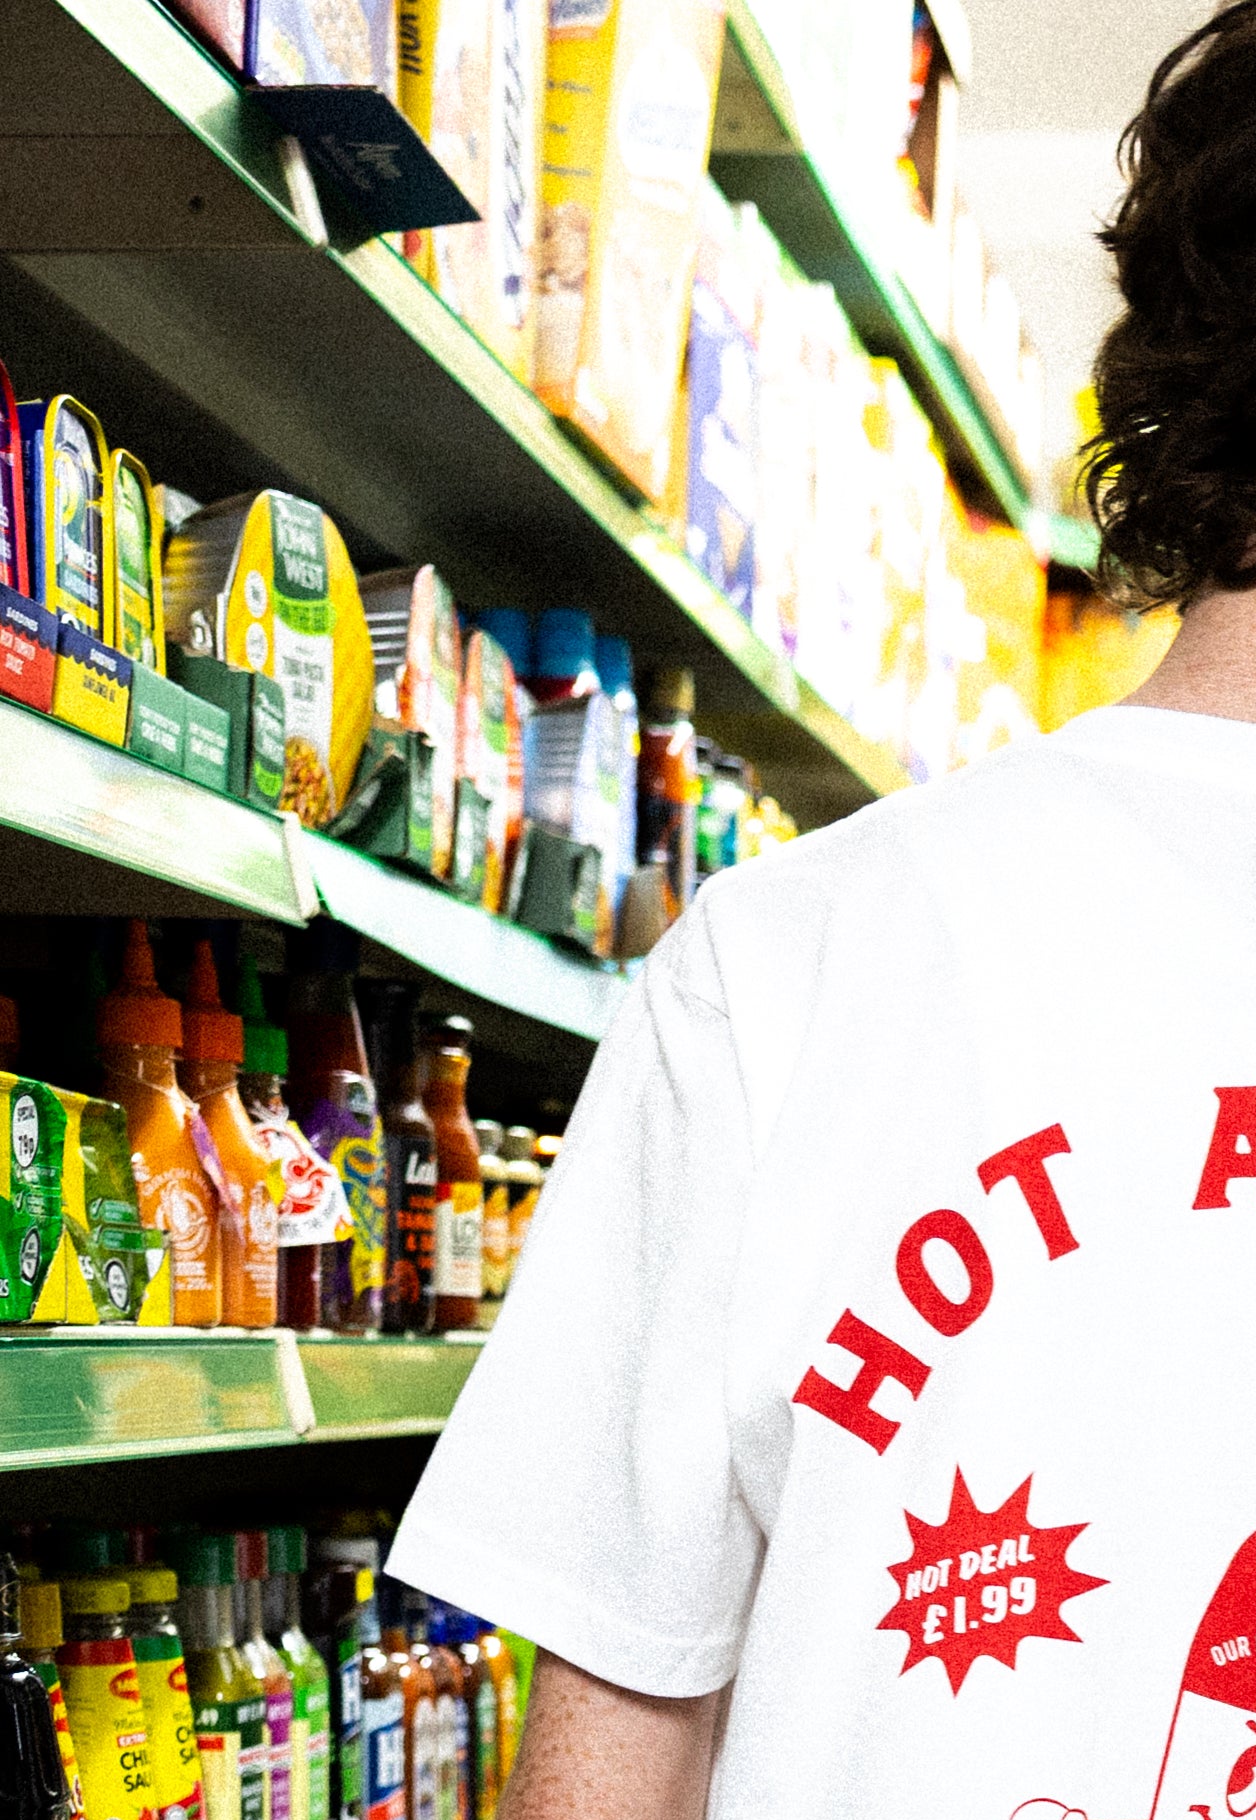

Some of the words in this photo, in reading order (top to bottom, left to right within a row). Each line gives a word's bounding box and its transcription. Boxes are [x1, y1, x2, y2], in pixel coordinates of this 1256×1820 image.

[792, 1122, 1081, 1455] HOT
[905, 1559, 953, 1601] HOT
[958, 1534, 1035, 1580] DEAL
[921, 1576, 1037, 1645] £1.99
[1210, 1636, 1251, 1666] OUR
